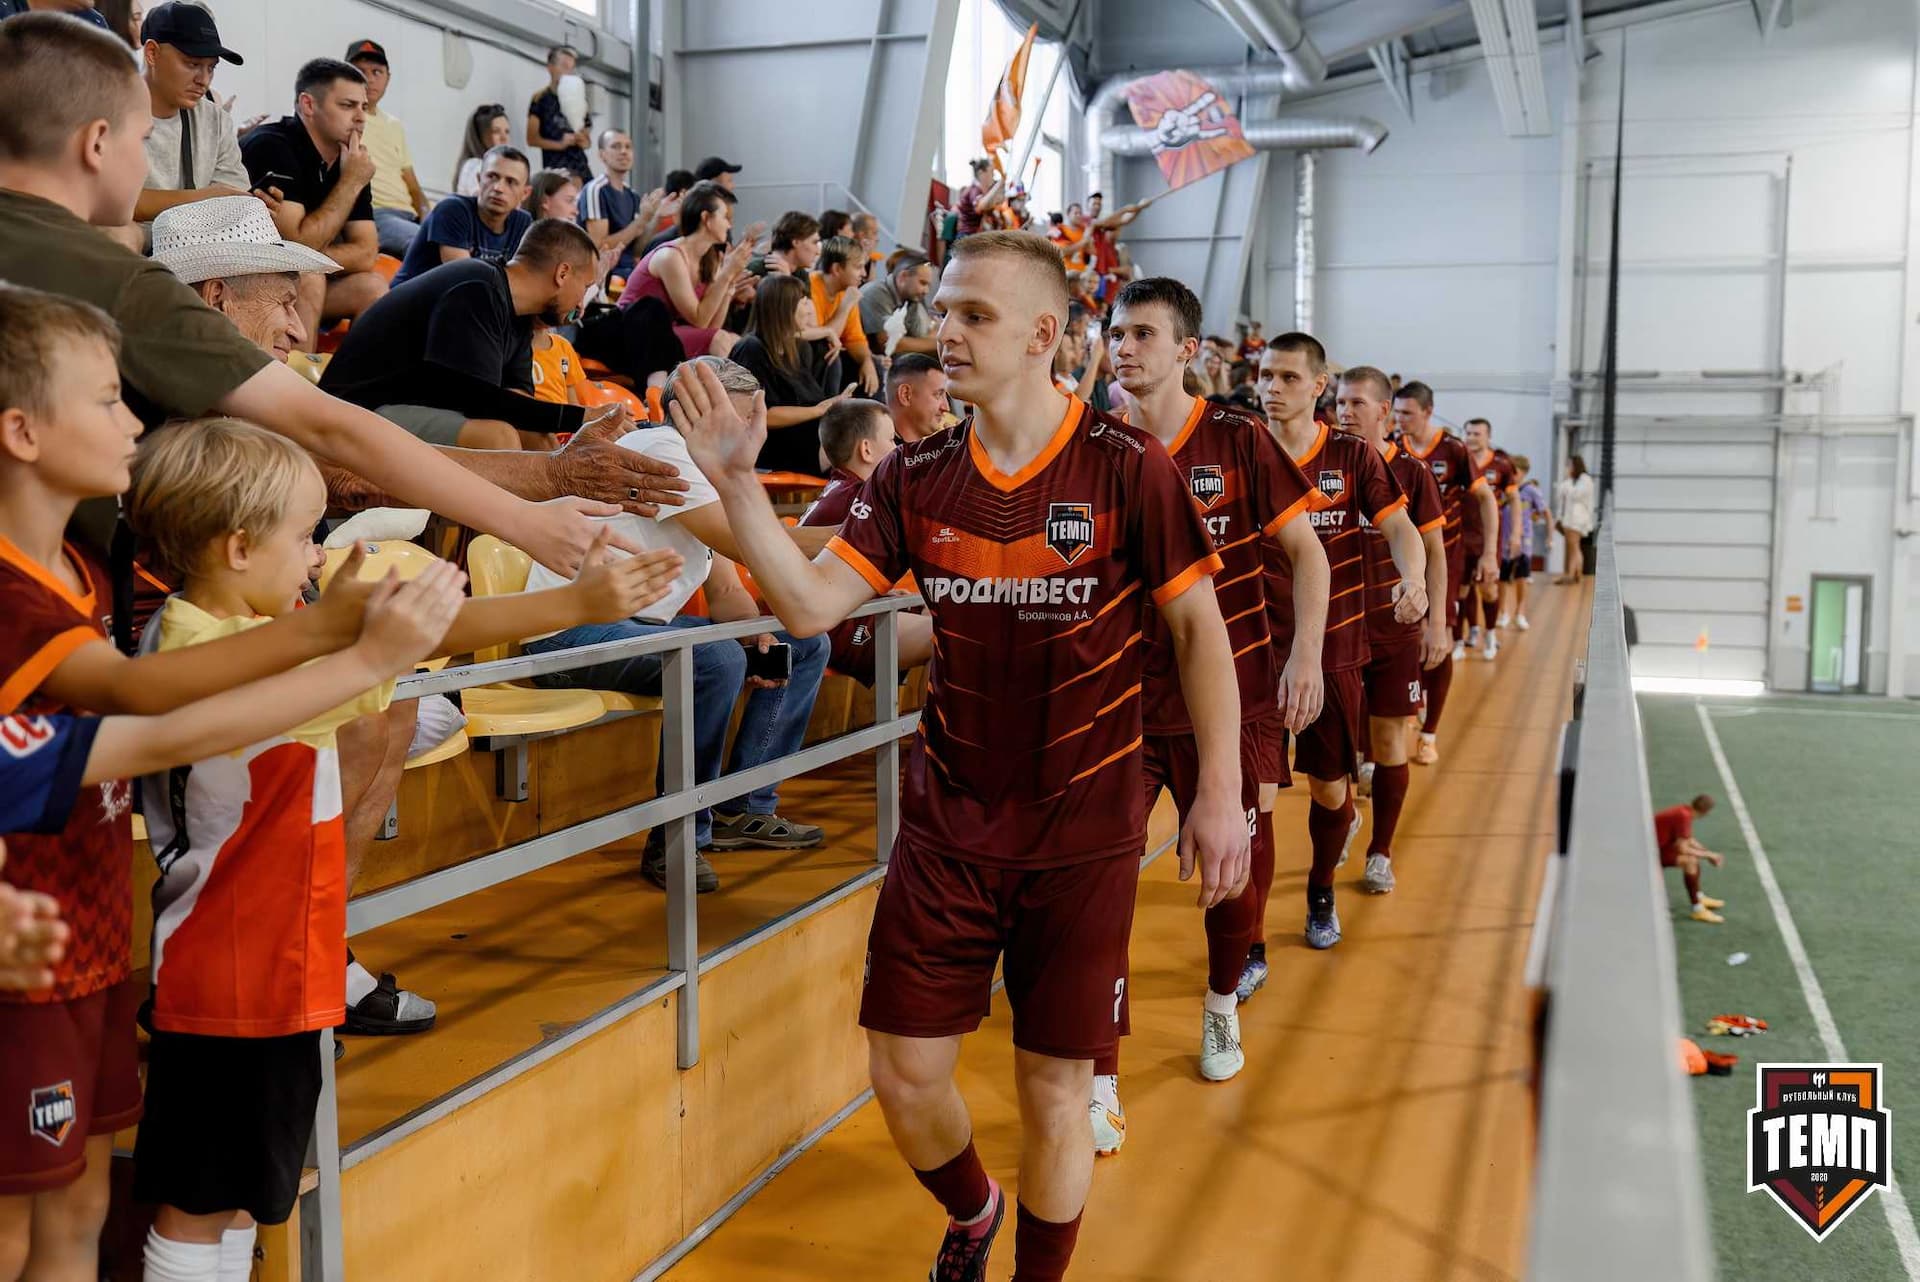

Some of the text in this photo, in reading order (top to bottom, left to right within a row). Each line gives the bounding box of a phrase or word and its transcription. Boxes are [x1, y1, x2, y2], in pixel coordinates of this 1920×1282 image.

[1194, 478, 1221, 493] ТЕМП
[1321, 479, 1343, 491] ТЕМП
[1050, 519, 1090, 542] ТЕМП
[34, 1099, 73, 1128] ТЕМП
